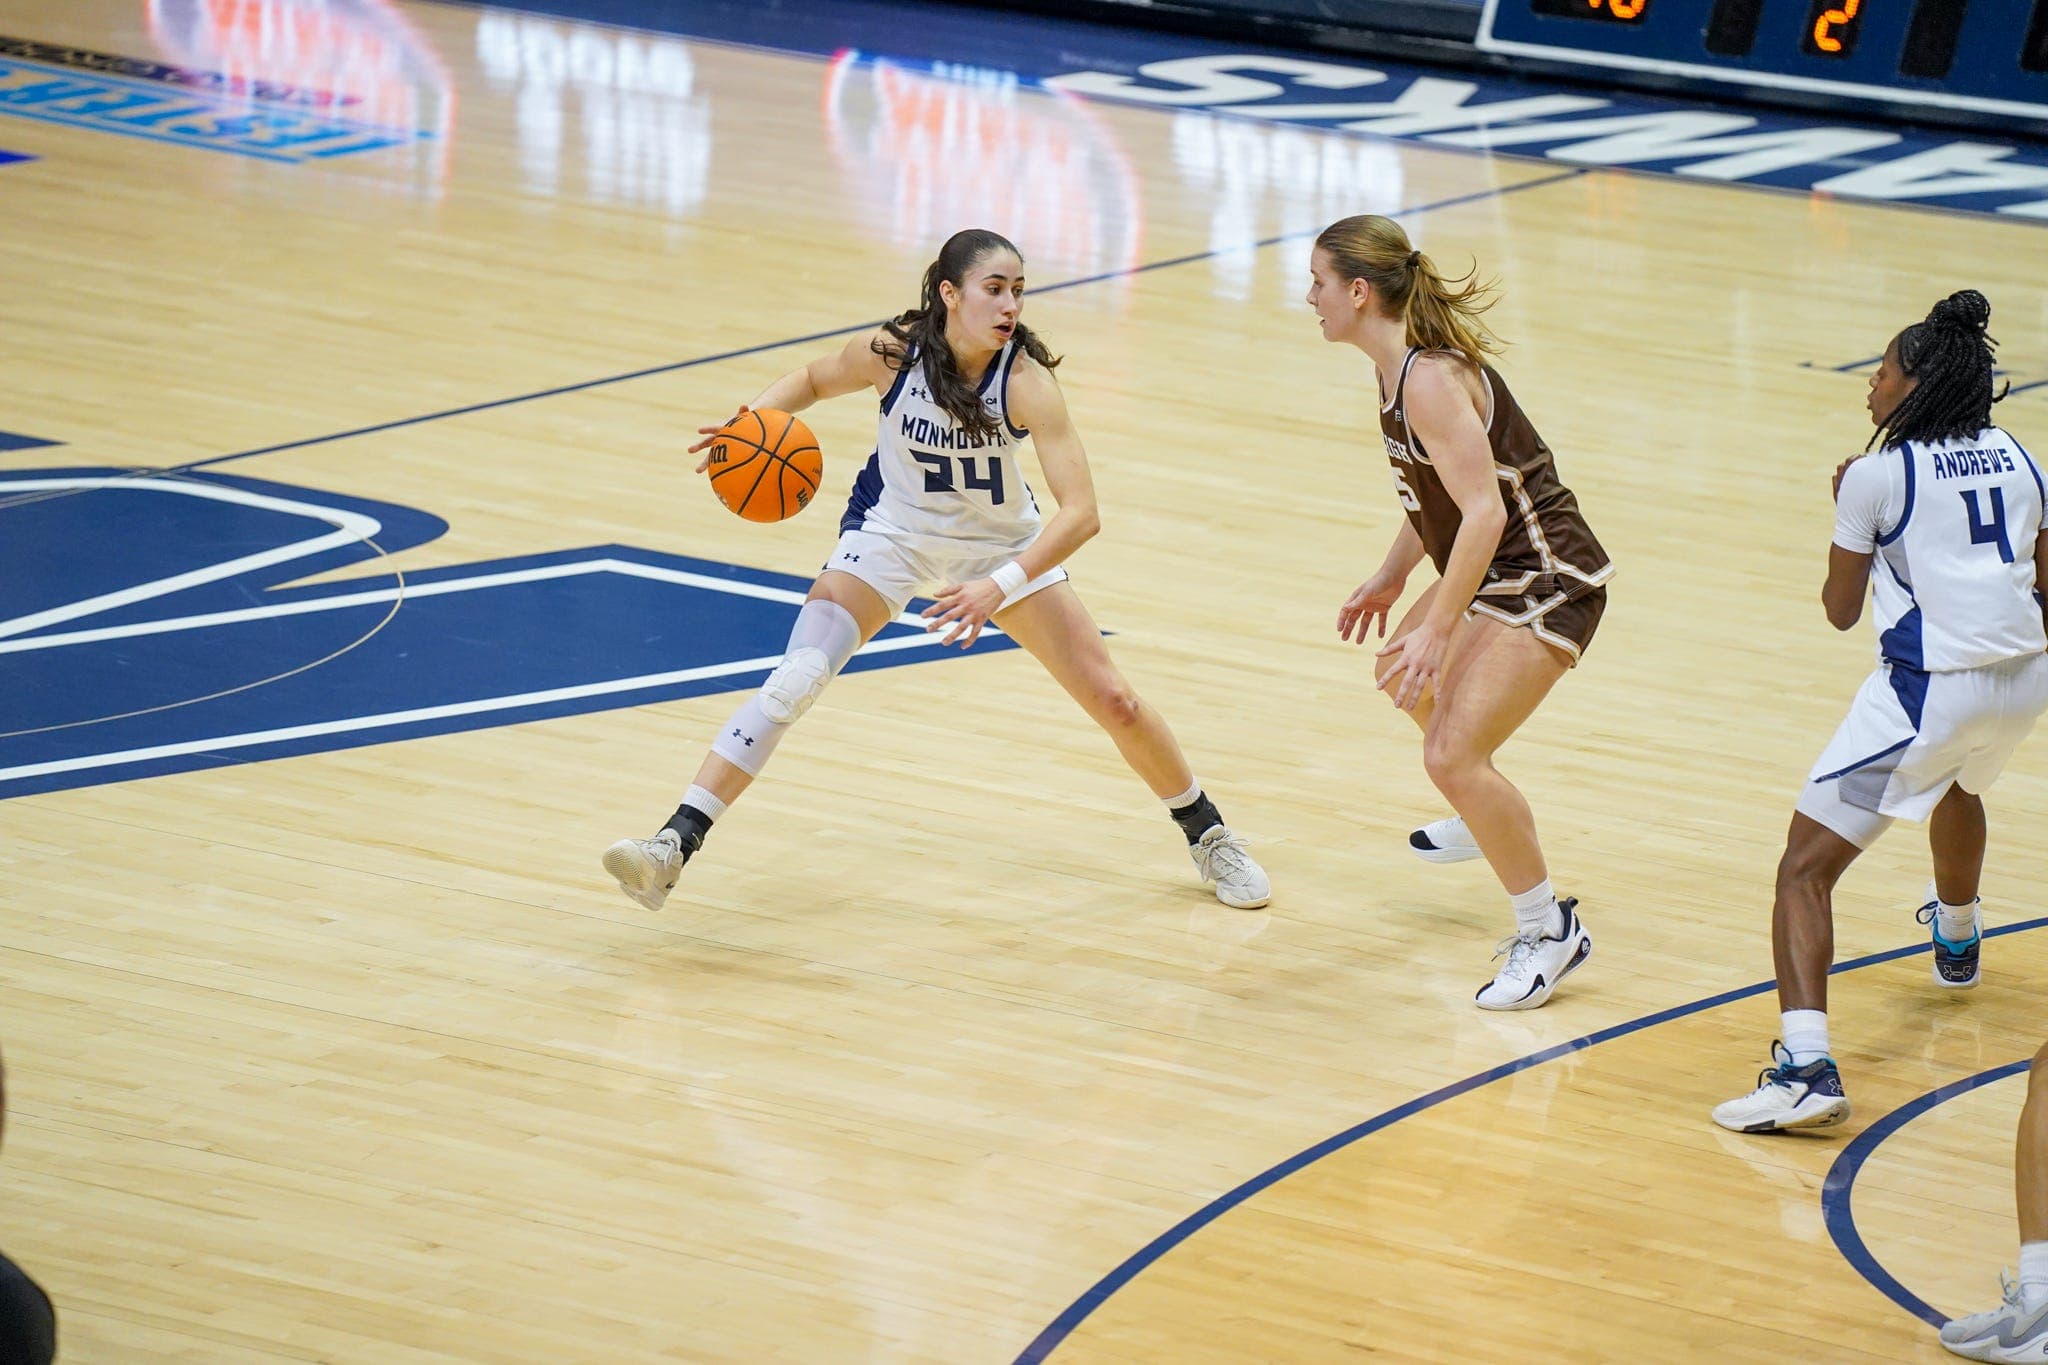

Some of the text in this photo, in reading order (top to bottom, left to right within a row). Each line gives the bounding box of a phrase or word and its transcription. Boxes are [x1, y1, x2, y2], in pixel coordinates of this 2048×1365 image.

[1041, 54, 2048, 218] AWKS
[908, 448, 1005, 505] 24
[1932, 448, 2015, 480] ANDREWS
[1958, 486, 2015, 563] 4
